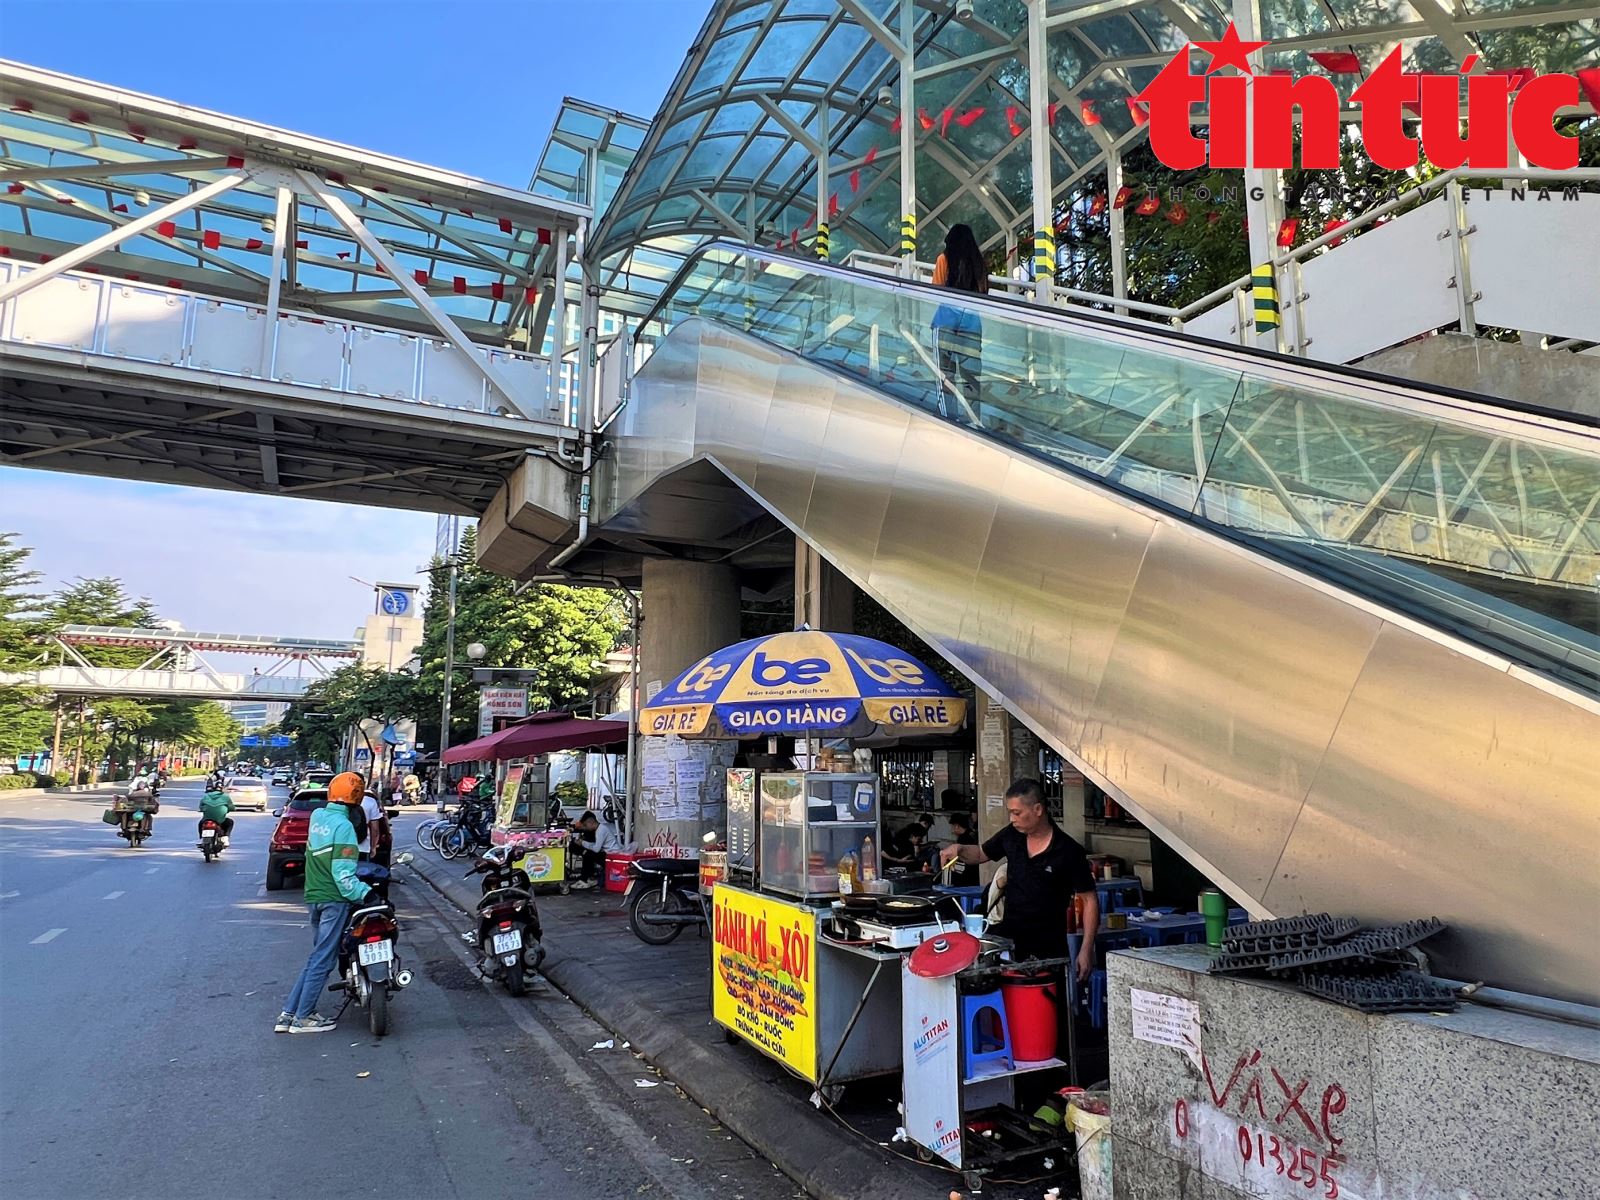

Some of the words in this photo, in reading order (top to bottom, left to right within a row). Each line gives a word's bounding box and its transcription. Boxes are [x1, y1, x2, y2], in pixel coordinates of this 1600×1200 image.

[676, 657, 732, 693] be
[751, 652, 831, 687] be
[843, 648, 925, 685] be
[653, 708, 676, 731] GIÁ
[729, 709, 782, 727] GIAO
[786, 703, 847, 725] HÀNG
[889, 700, 922, 723] GIÁ
[924, 699, 949, 723] RẺ
[714, 897, 747, 956] BÁNH
[750, 909, 768, 964] MÌ
[779, 920, 810, 983] XÔI
[913, 1019, 949, 1051] ALUTITAN
